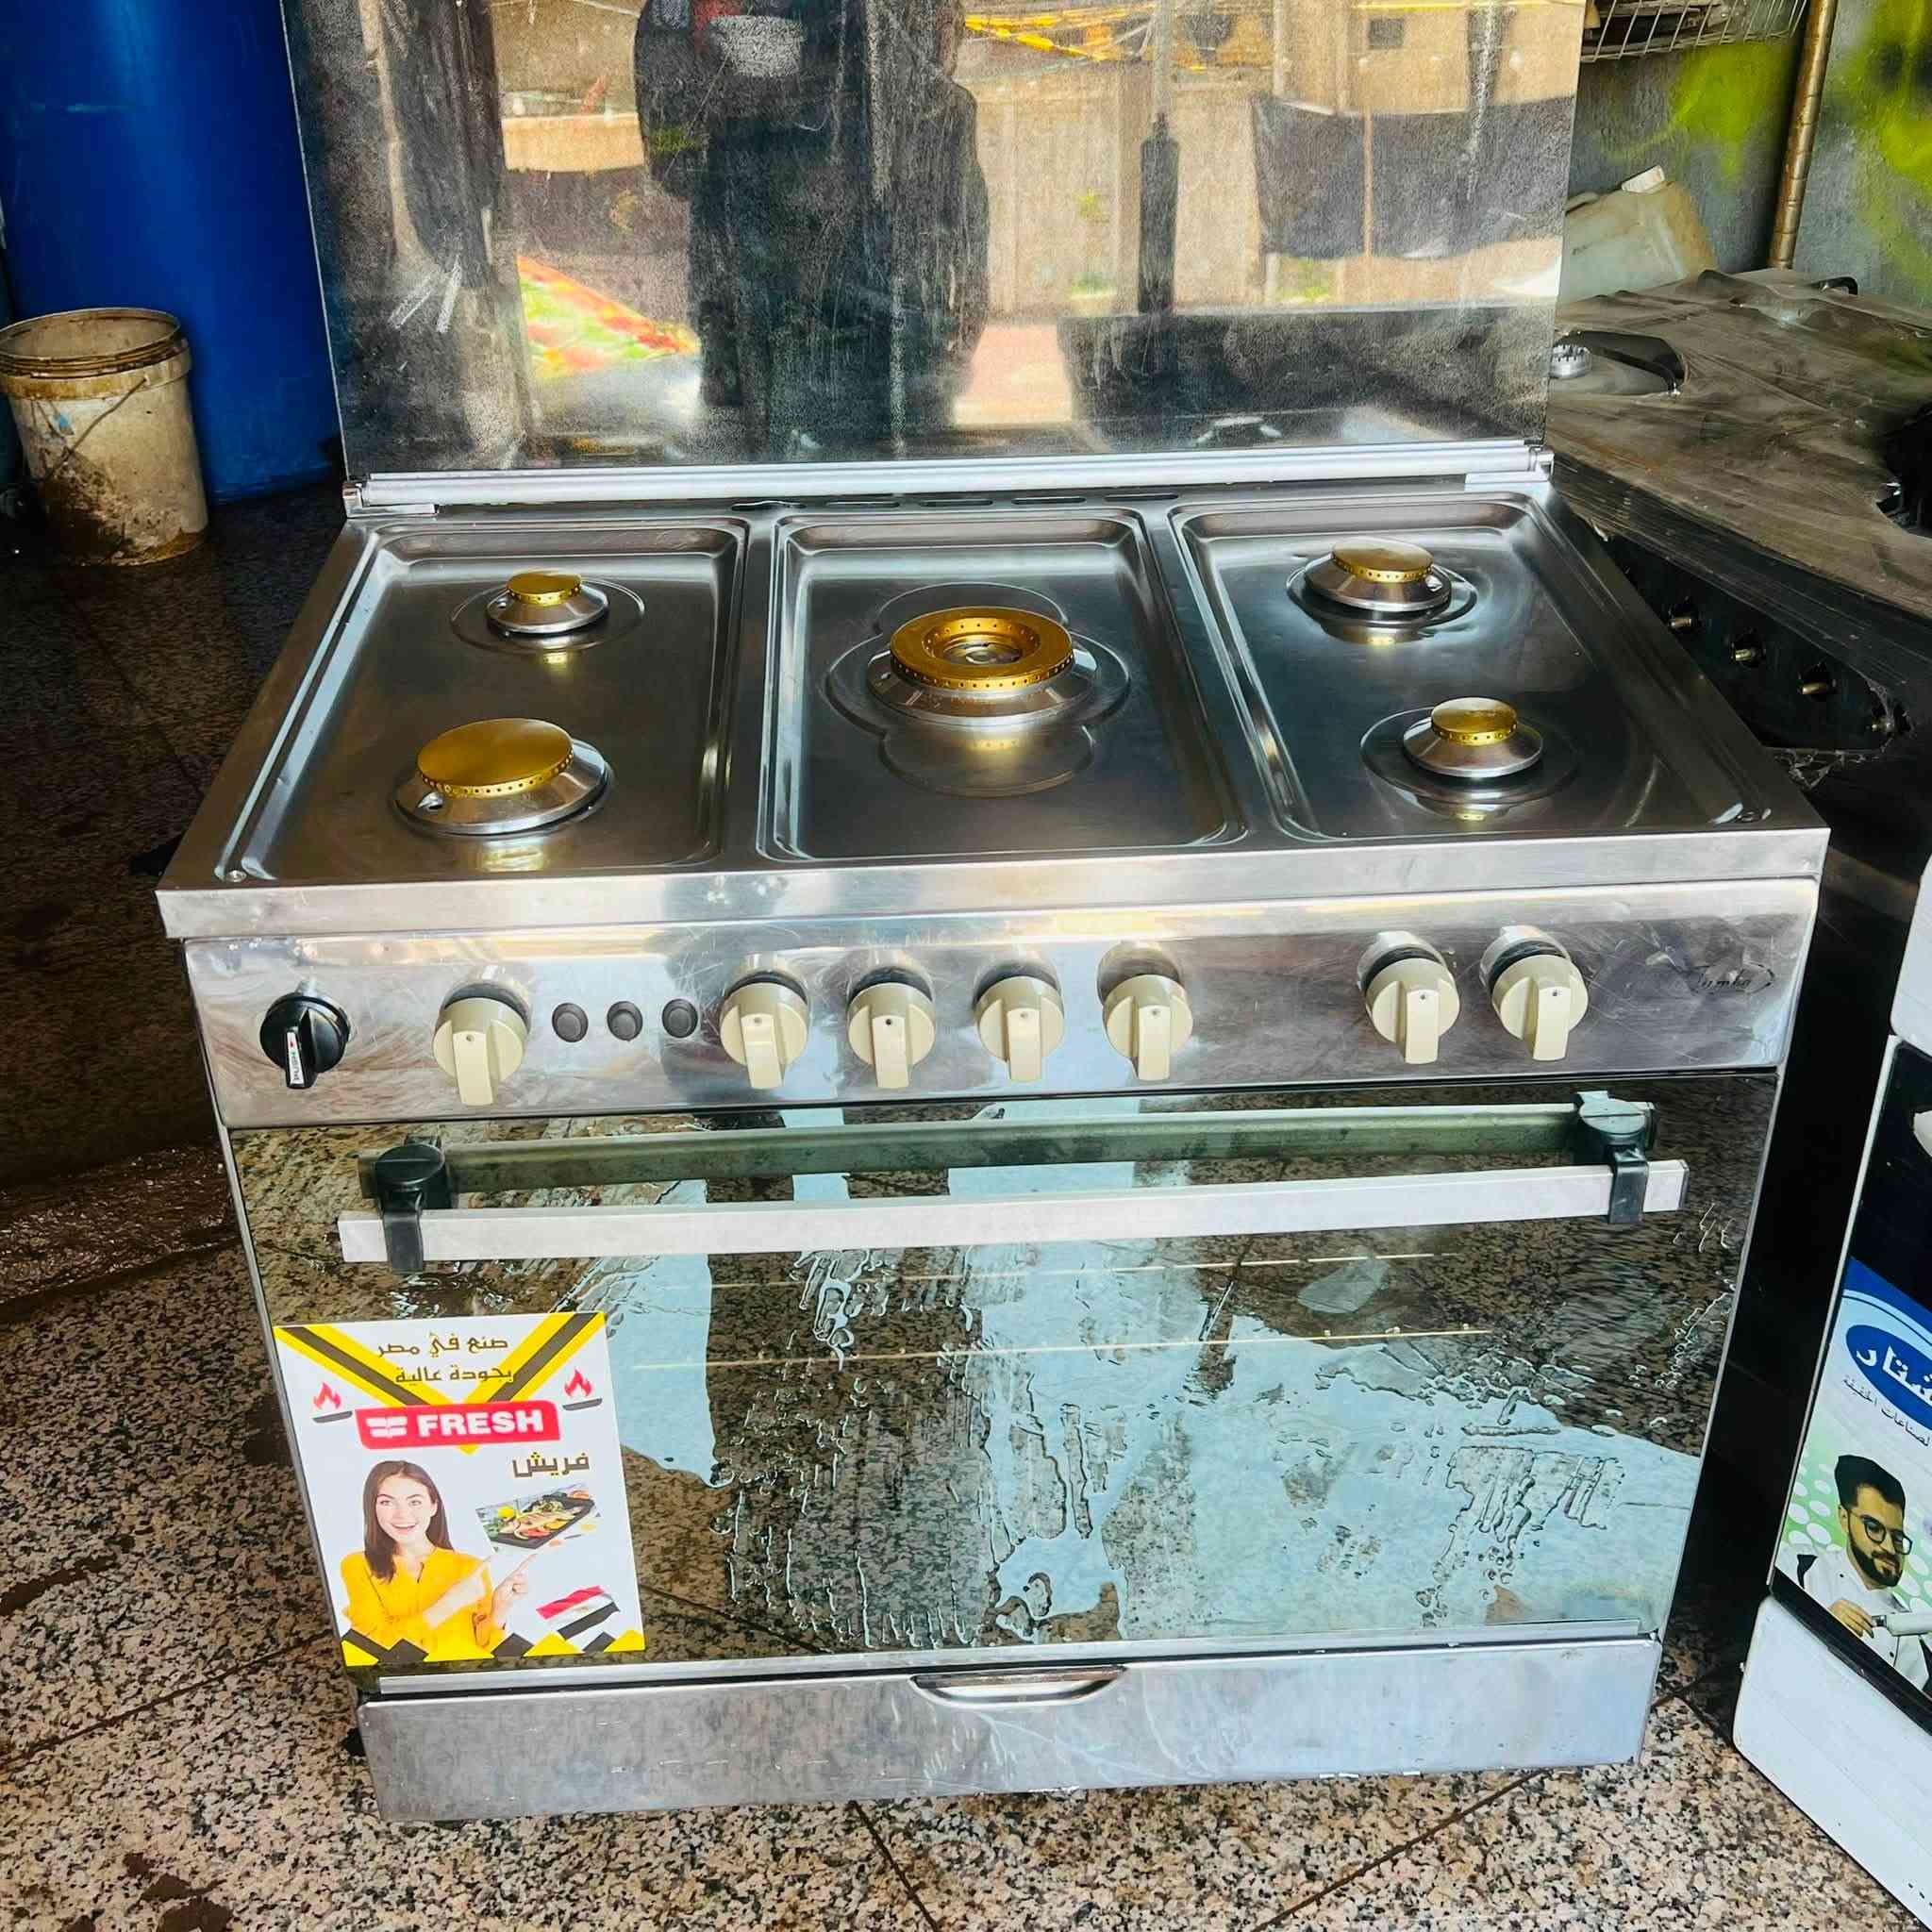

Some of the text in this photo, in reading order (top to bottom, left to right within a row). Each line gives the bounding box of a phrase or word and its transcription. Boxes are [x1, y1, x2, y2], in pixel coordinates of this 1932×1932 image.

[377, 1342, 420, 1357] مصر
[467, 1336, 508, 1354] صنع
[395, 1364, 513, 1386] بجودة عالية
[416, 1408, 544, 1439] FRESH
[1881, 1404, 1931, 1447] لصناعات
[511, 1451, 591, 1478] فريش
